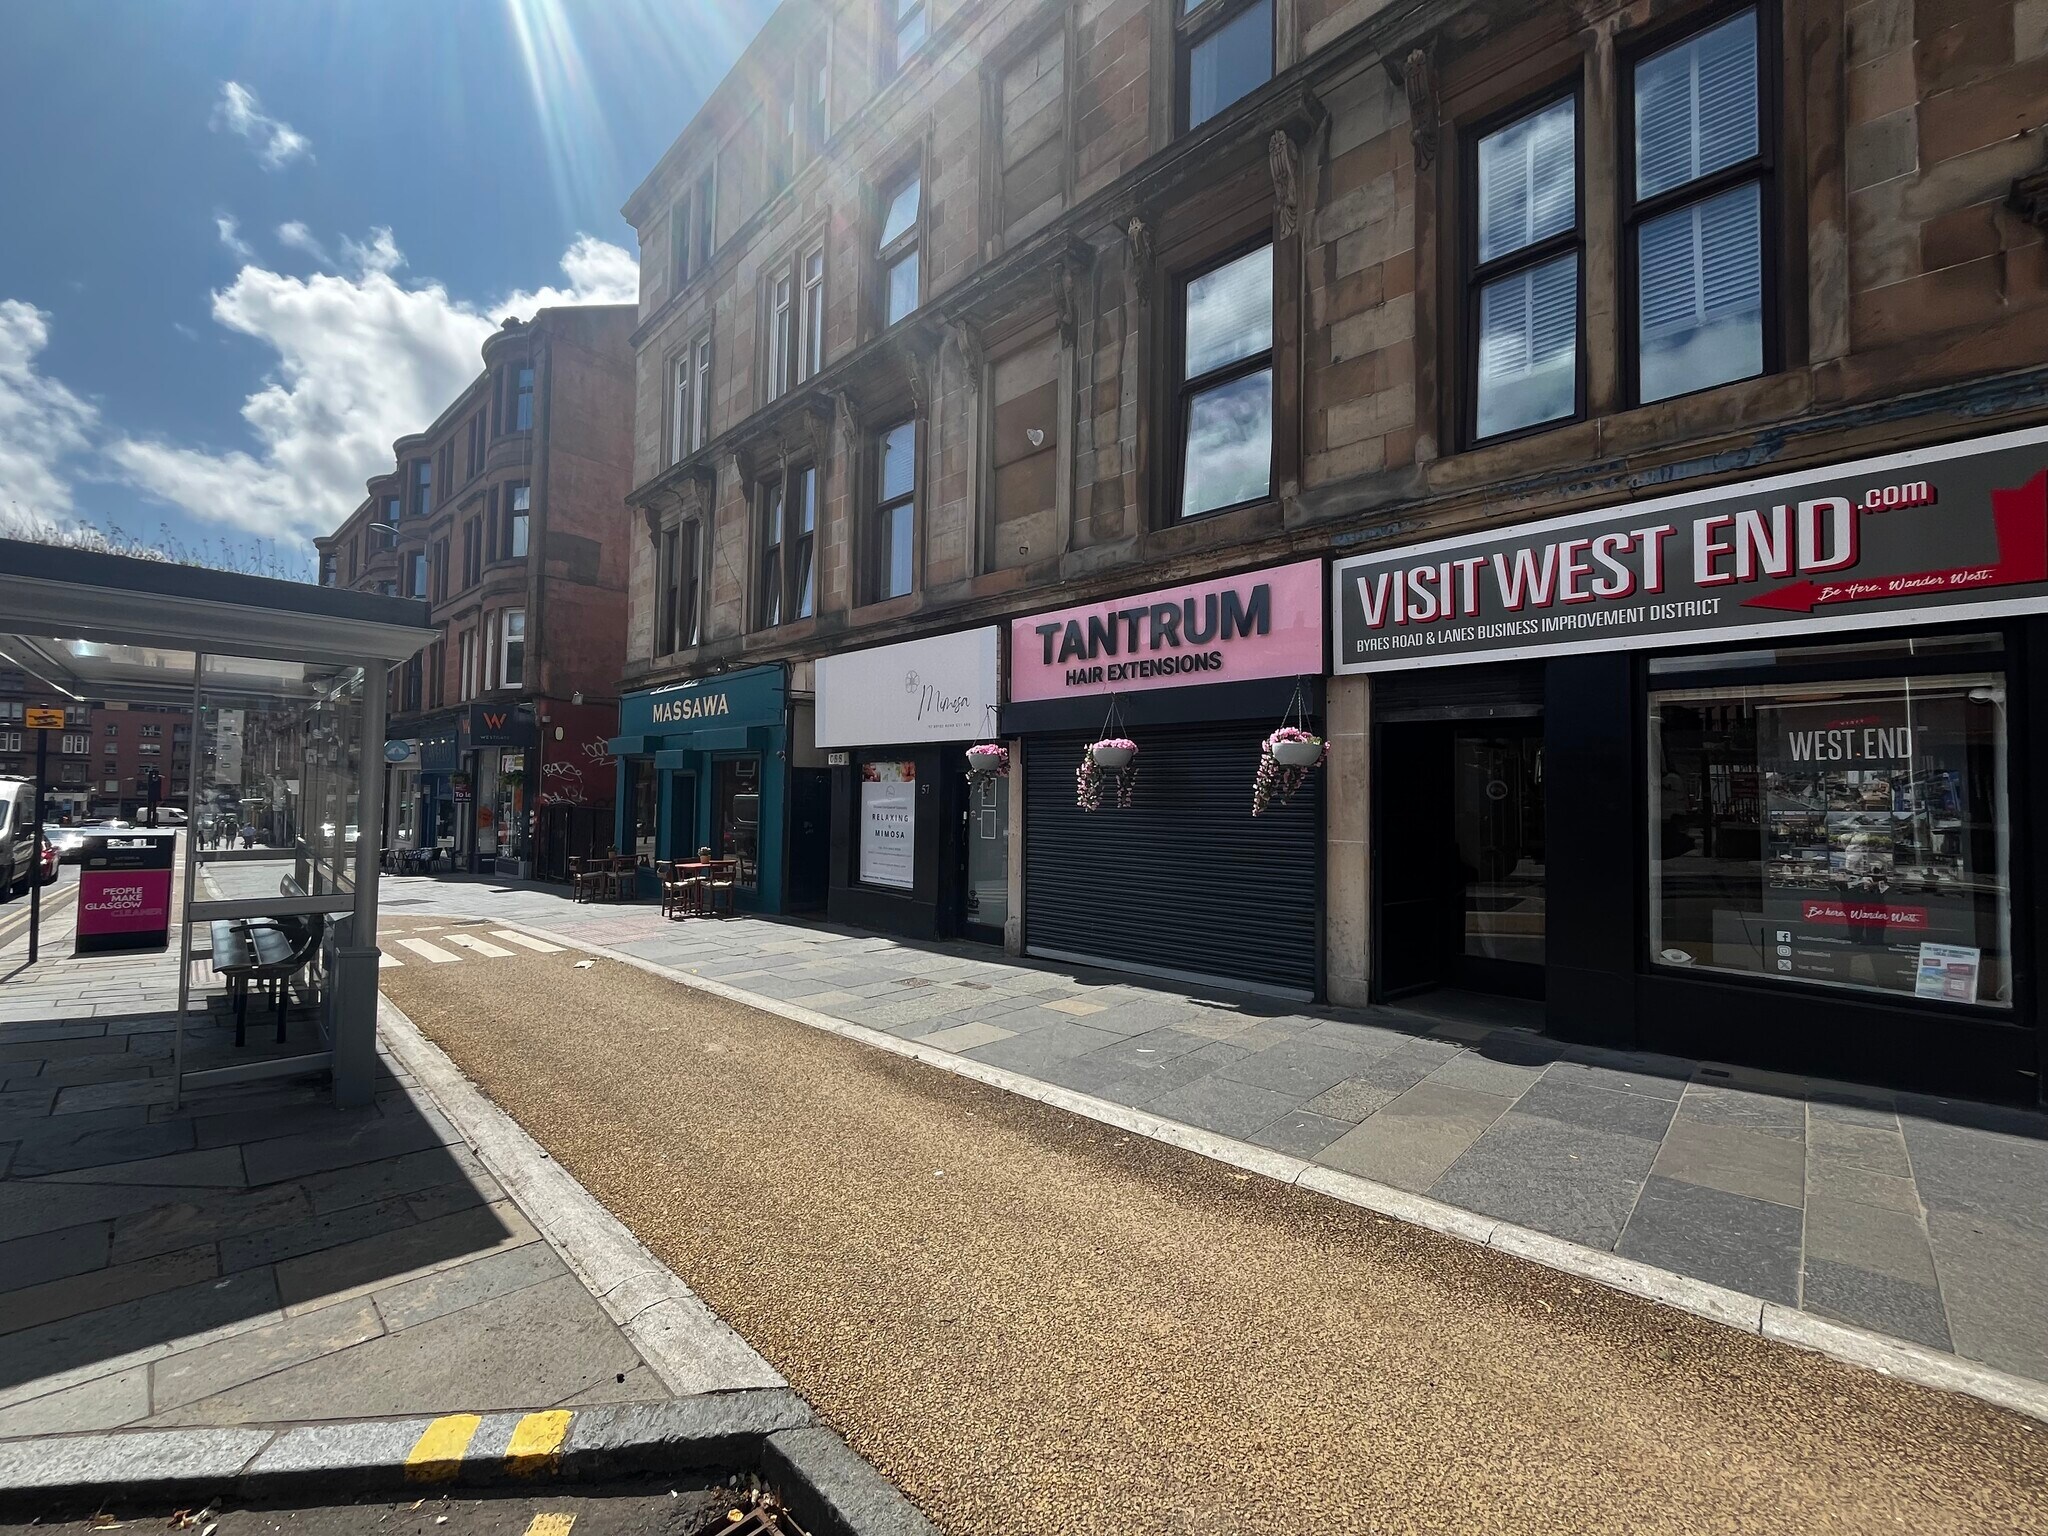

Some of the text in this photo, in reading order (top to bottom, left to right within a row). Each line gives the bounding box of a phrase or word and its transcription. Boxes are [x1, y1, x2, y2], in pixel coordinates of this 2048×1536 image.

[1356, 556, 1486, 627] VISIT
[1492, 524, 1674, 609] WEST
[1692, 496, 1855, 585] END
[1818, 569, 1996, 601] Be Here. Wander West.
[1036, 583, 1271, 665] TANTRUM
[1356, 597, 1721, 653] BYRES ROAD & LANES BUSINESS IMPROVEMENT DISTRICT
[1066, 651, 1222, 686] HAIR EXTENSIONS
[652, 693, 729, 723] MASSAWA
[917, 684, 971, 720] Mimosa
[1788, 727, 1912, 762] WEST END
[922, 784, 931, 796] 57
[872, 813, 909, 823] RELAXING
[874, 830, 905, 839] MIMOSA
[85, 901, 143, 911] GLASGOW
[103, 886, 144, 896] PEOPLE
[111, 894, 143, 902] MAKE
[1805, 906, 1824, 918] Be
[1850, 909, 1888, 921] Wander
